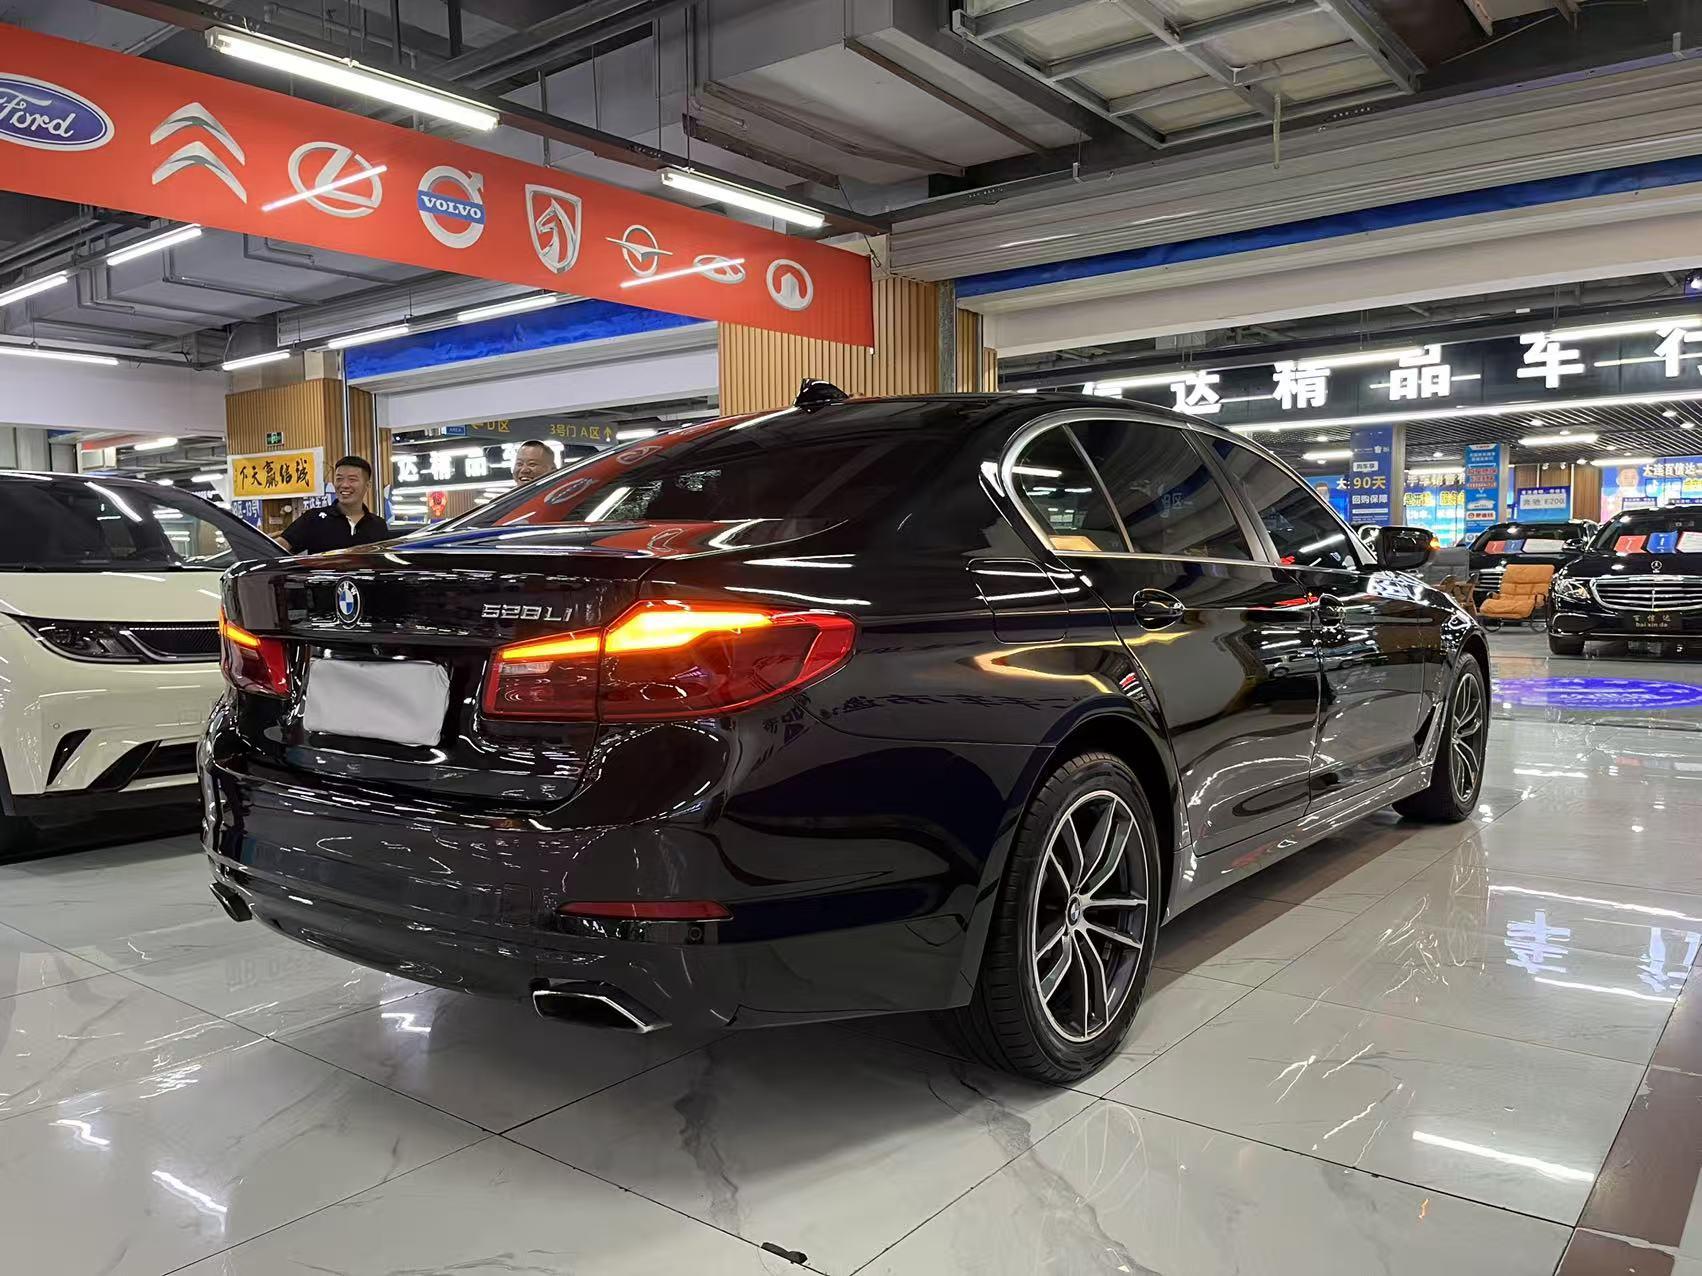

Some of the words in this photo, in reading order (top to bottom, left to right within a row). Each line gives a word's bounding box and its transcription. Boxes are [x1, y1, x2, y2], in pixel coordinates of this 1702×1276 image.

[0, 88, 74, 138] Ford
[421, 195, 482, 219] VOLVO
[548, 424, 577, 438] 3号门
[580, 426, 601, 440] A区
[1353, 475, 1386, 489] 90天
[1352, 494, 1388, 505] 回购保障
